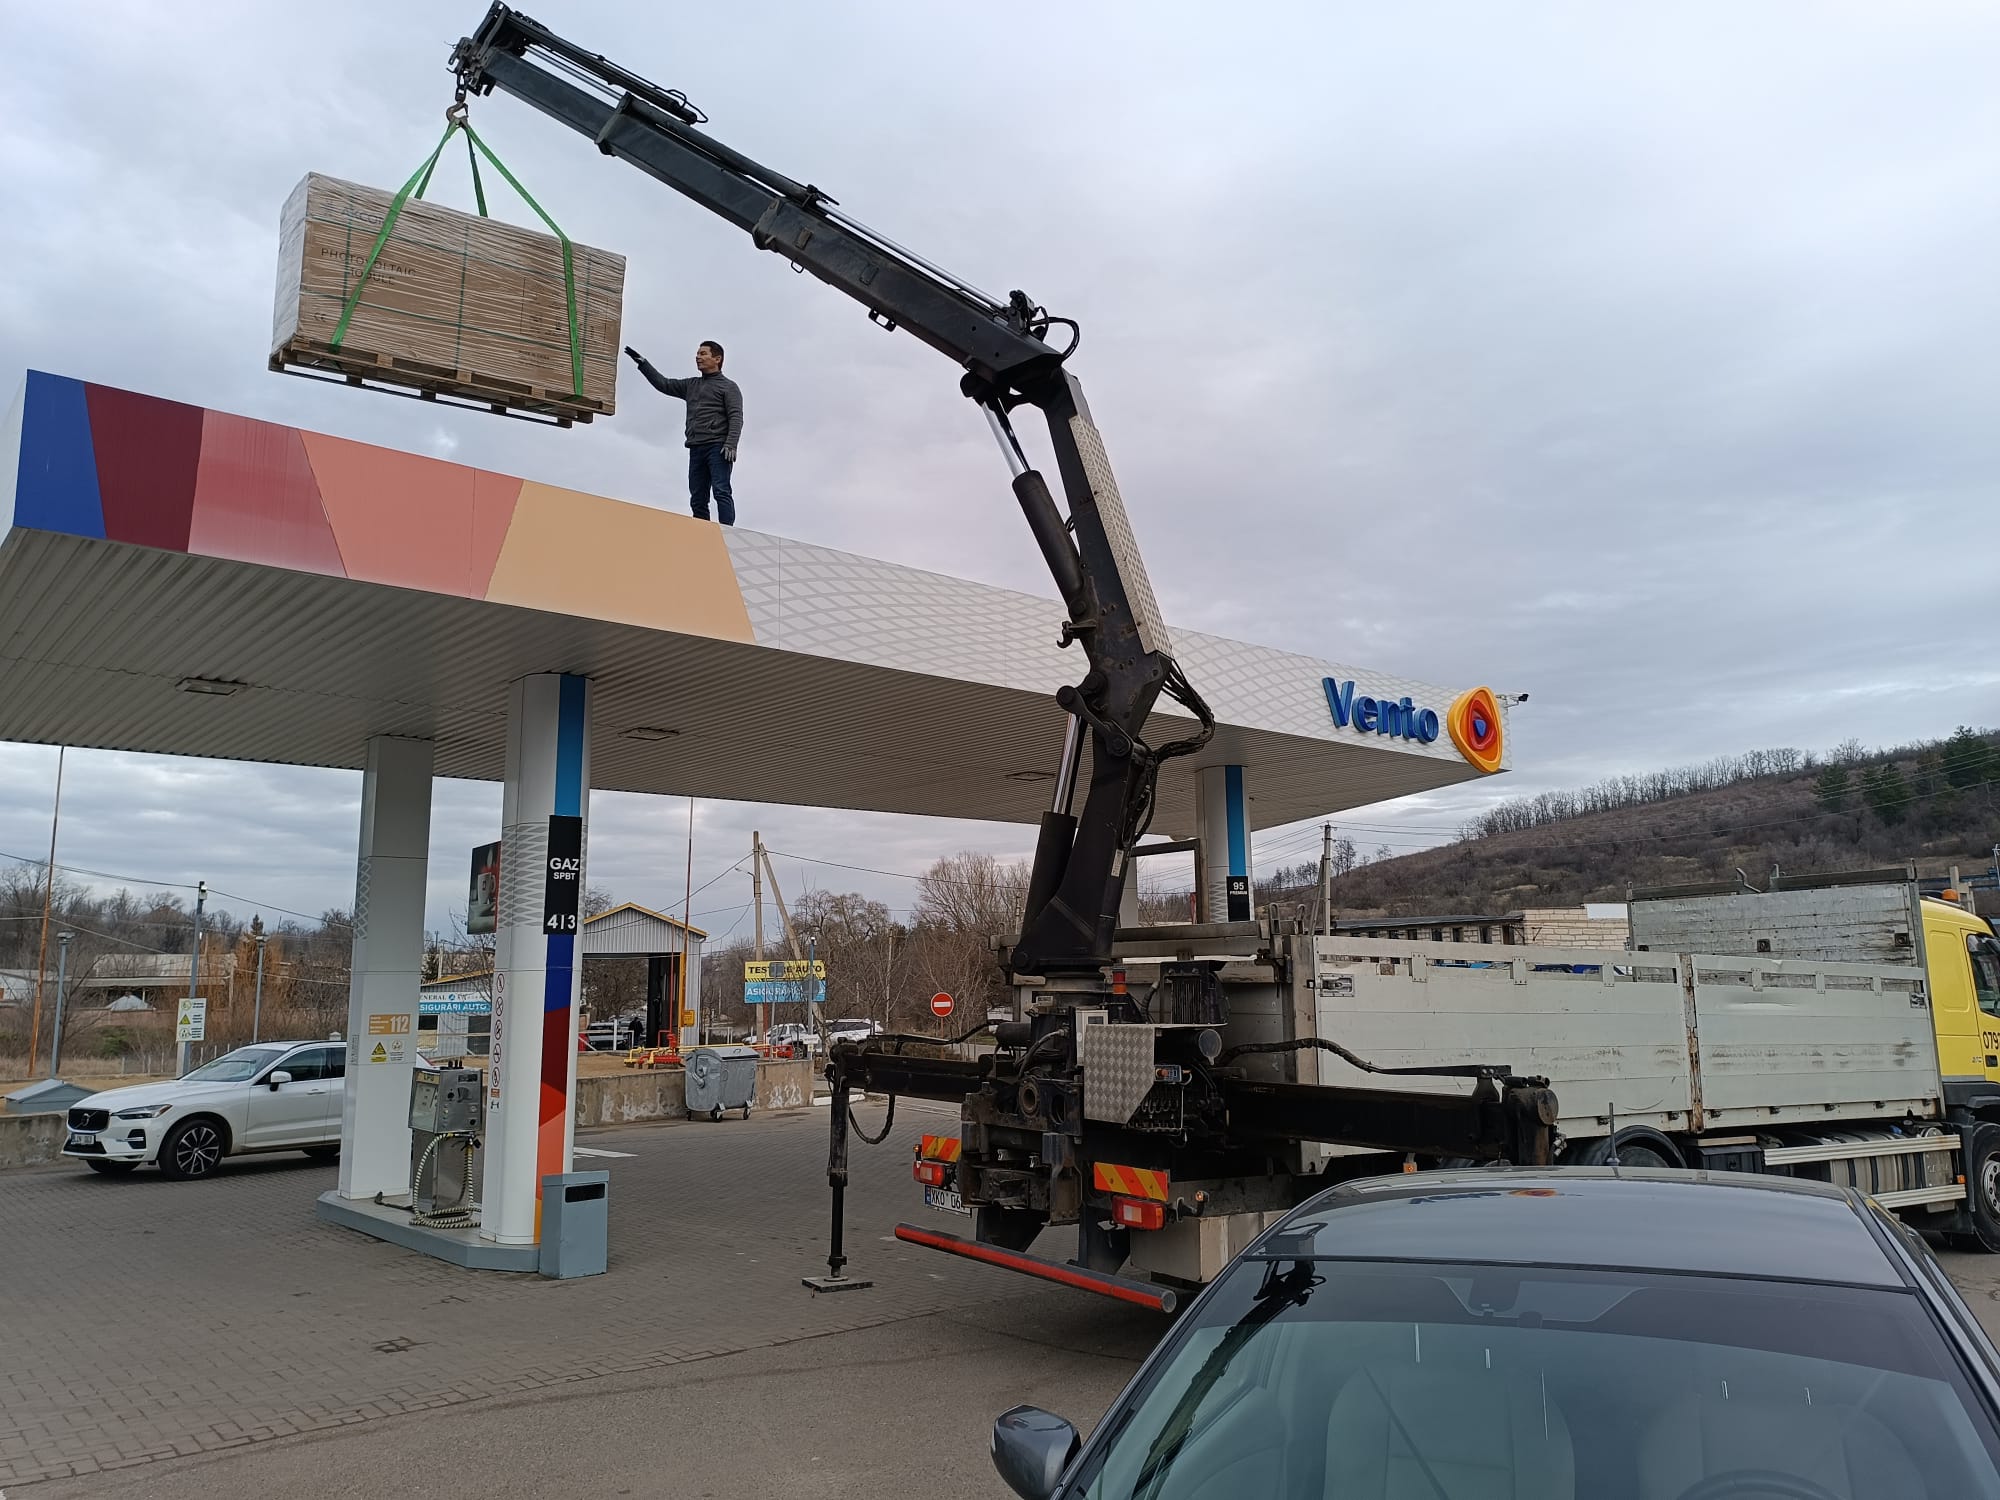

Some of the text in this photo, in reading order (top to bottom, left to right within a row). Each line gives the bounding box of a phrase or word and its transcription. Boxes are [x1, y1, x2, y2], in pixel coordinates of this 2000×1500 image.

[321, 247, 417, 276] PHOTOOLTAIC
[1322, 677, 1439, 743] Vento
[549, 857, 579, 871] GAZ
[553, 872, 576, 880] SPBT
[1233, 881, 1245, 891] 95
[795, 964, 822, 974] AUO
[390, 1016, 409, 1033] 112
[1983, 1030, 2000, 1050] 079
